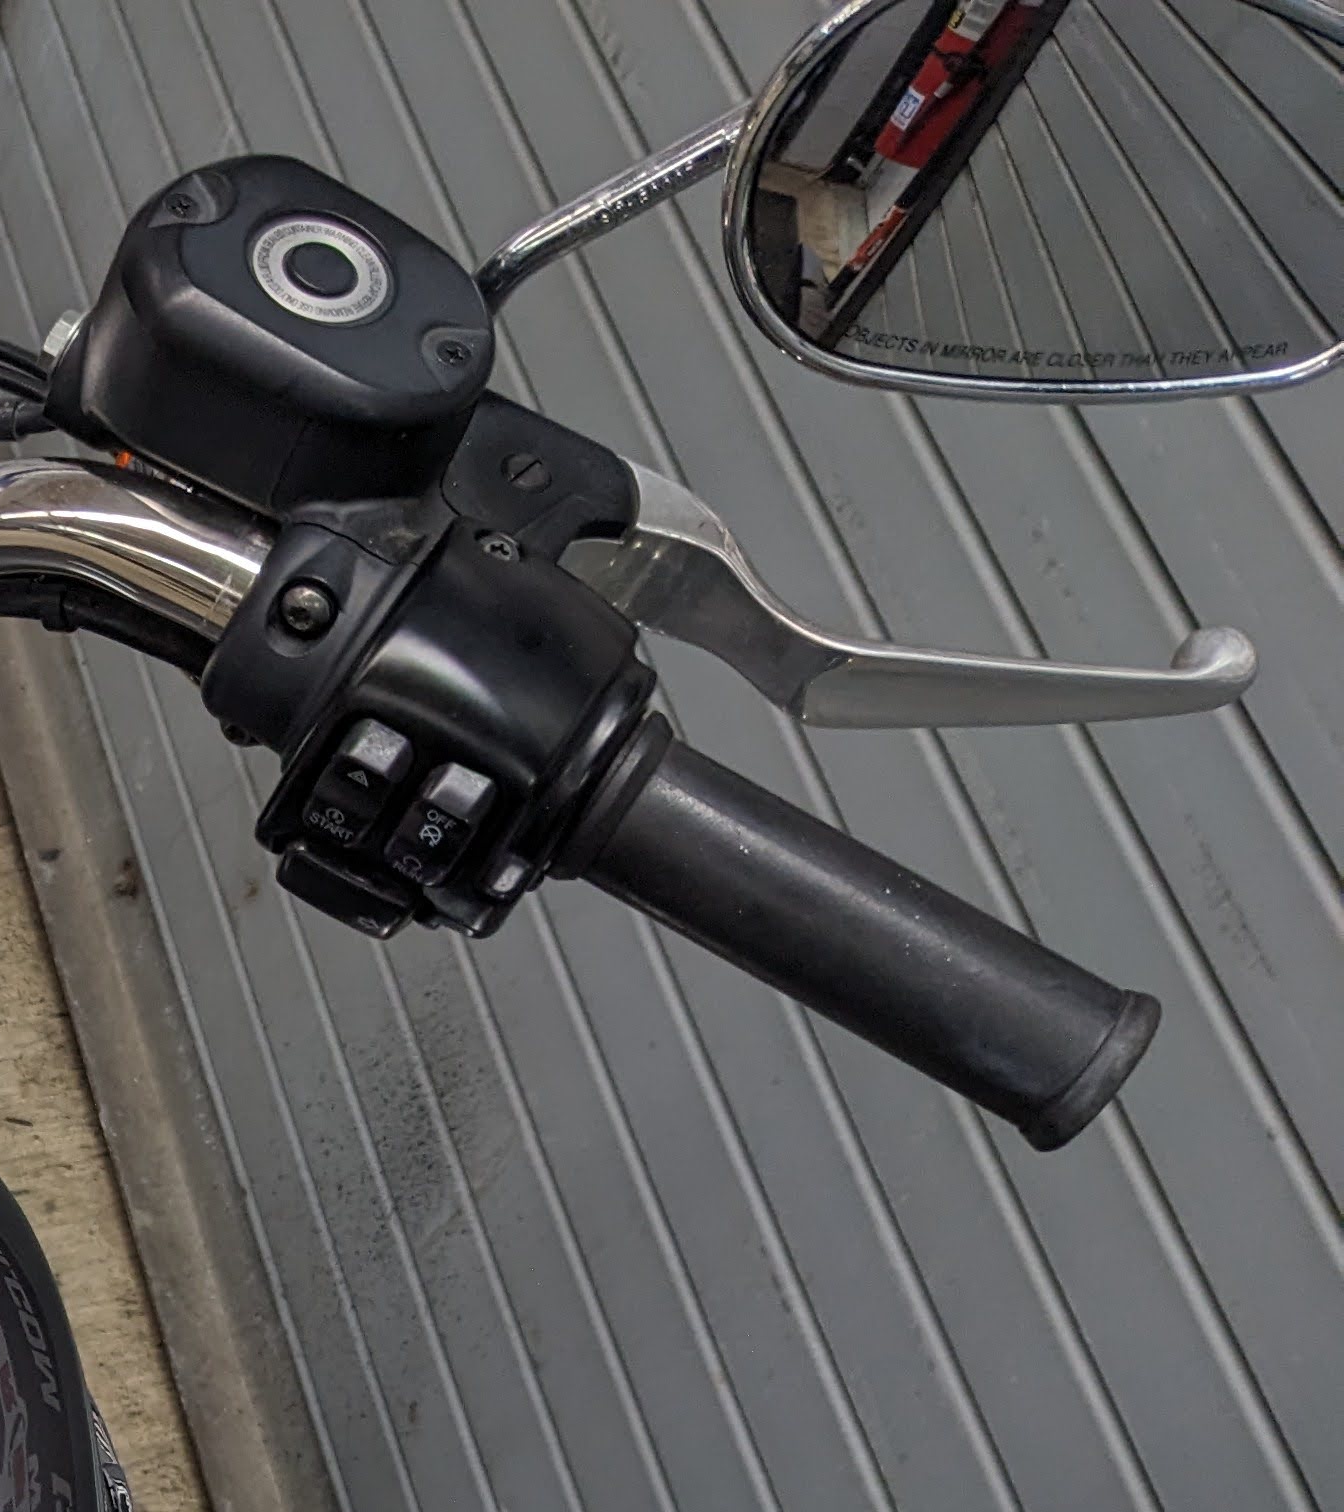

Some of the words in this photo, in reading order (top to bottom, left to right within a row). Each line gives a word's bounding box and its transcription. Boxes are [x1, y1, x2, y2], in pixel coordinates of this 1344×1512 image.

[845, 324, 918, 354] OBJECTS
[941, 343, 1006, 363] MIRROR
[1009, 351, 1044, 367] ARE
[1169, 349, 1211, 367] THEY
[1217, 341, 1289, 364] APPEAR
[309, 811, 355, 841] START
[426, 809, 457, 831] OFF
